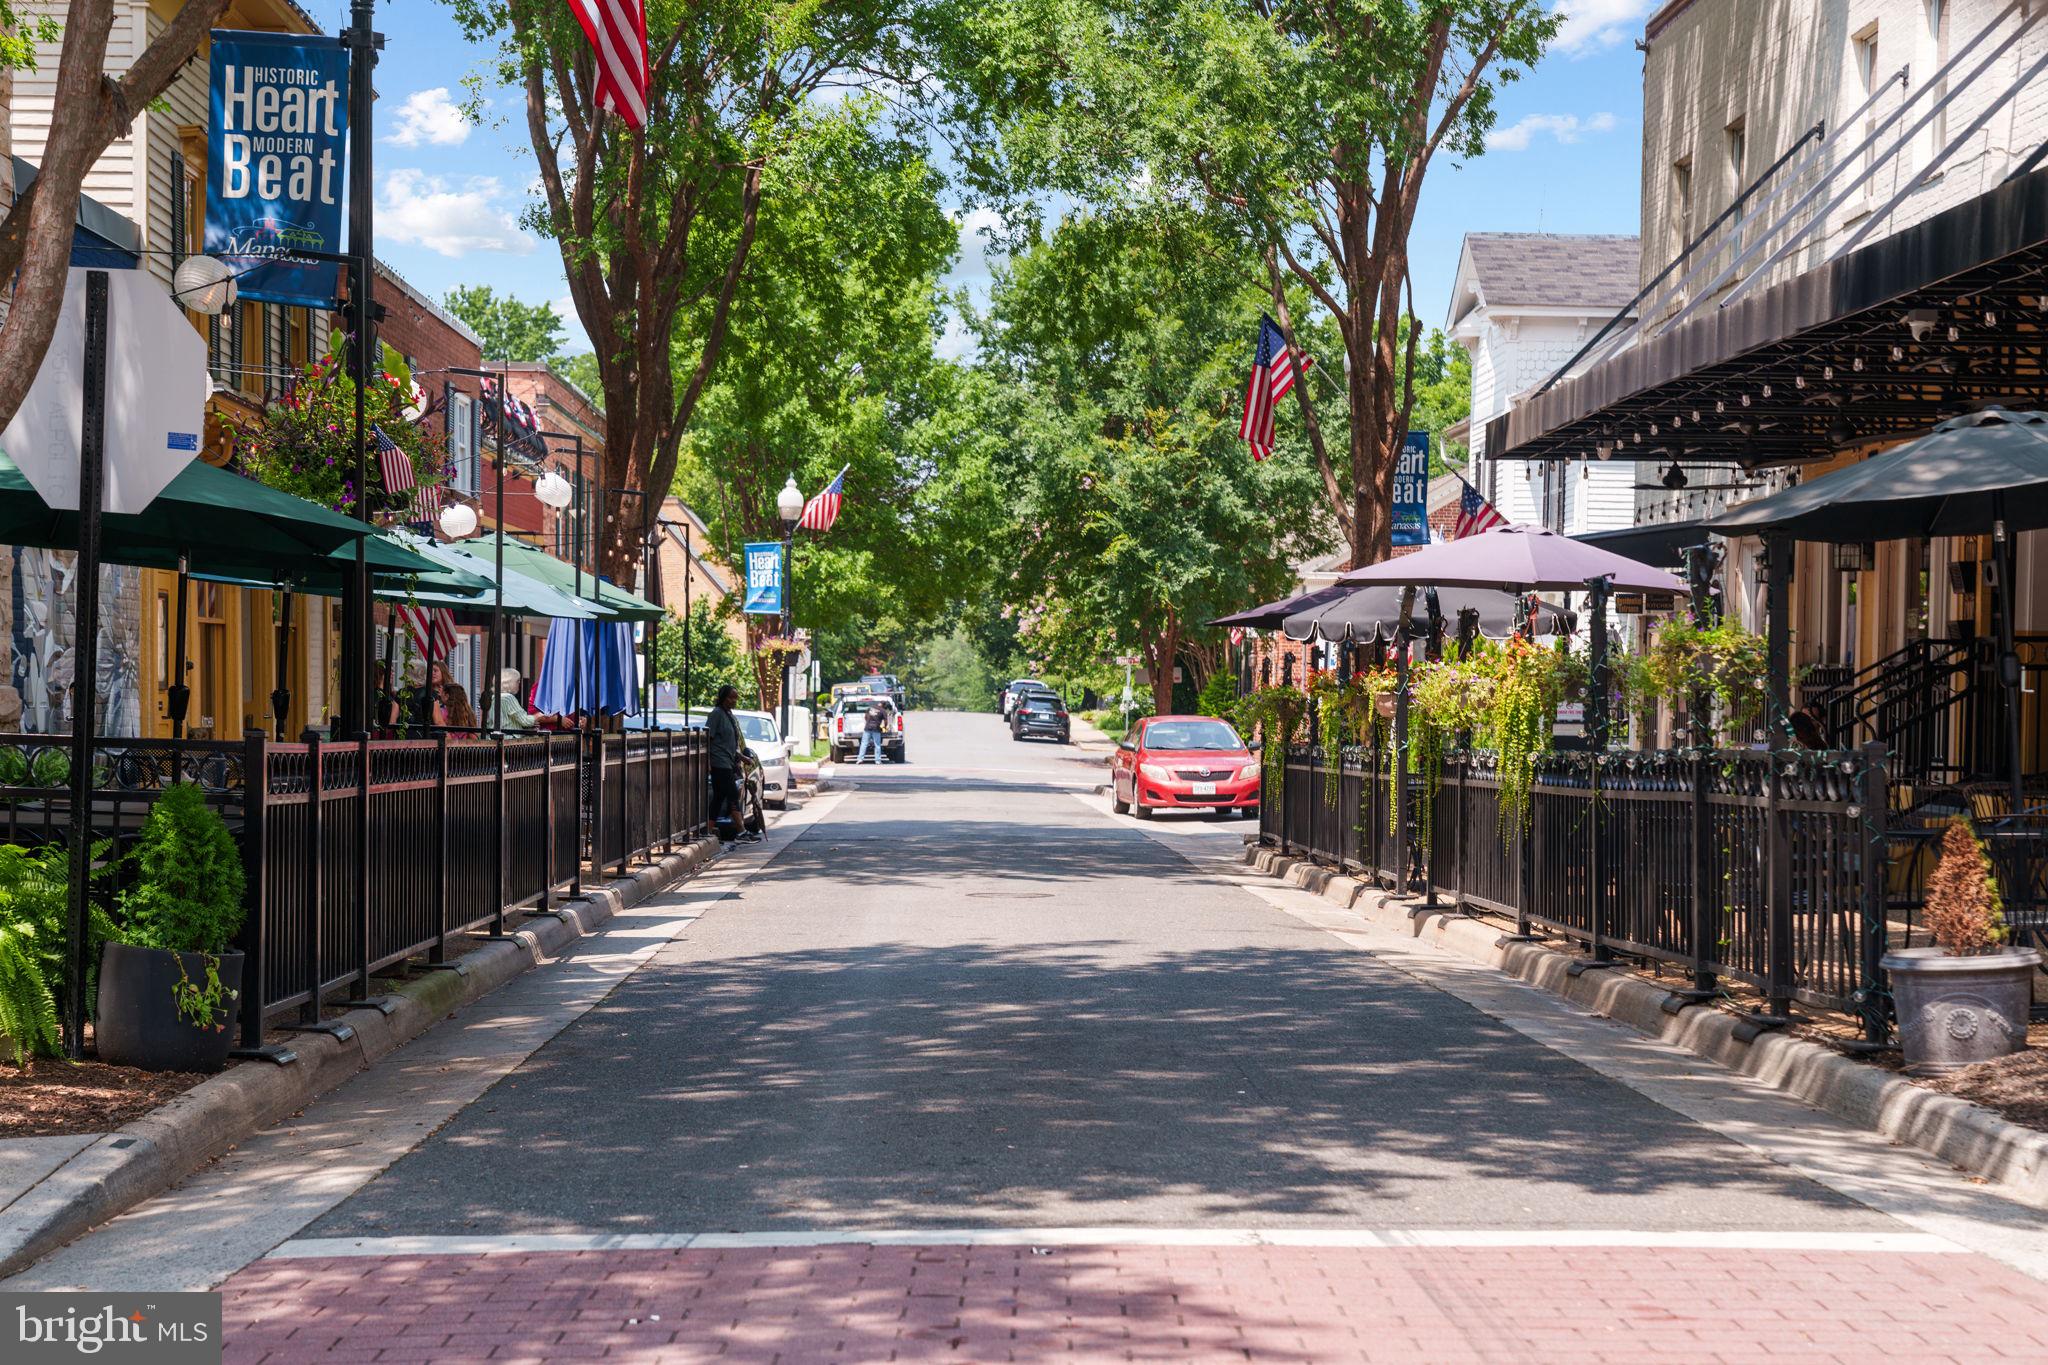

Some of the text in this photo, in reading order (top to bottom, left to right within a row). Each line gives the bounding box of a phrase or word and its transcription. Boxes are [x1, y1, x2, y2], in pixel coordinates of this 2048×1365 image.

[254, 67, 319, 86] HISTORIC
[223, 64, 339, 137] Heart
[252, 136, 314, 155] MODERN
[222, 133, 336, 205] Beat
[1393, 475, 1414, 484] ODERN
[1392, 478, 1424, 504] eat
[1391, 522, 1421, 530] anassas
[749, 552, 780, 570] Heart
[750, 569, 780, 588] Beat
